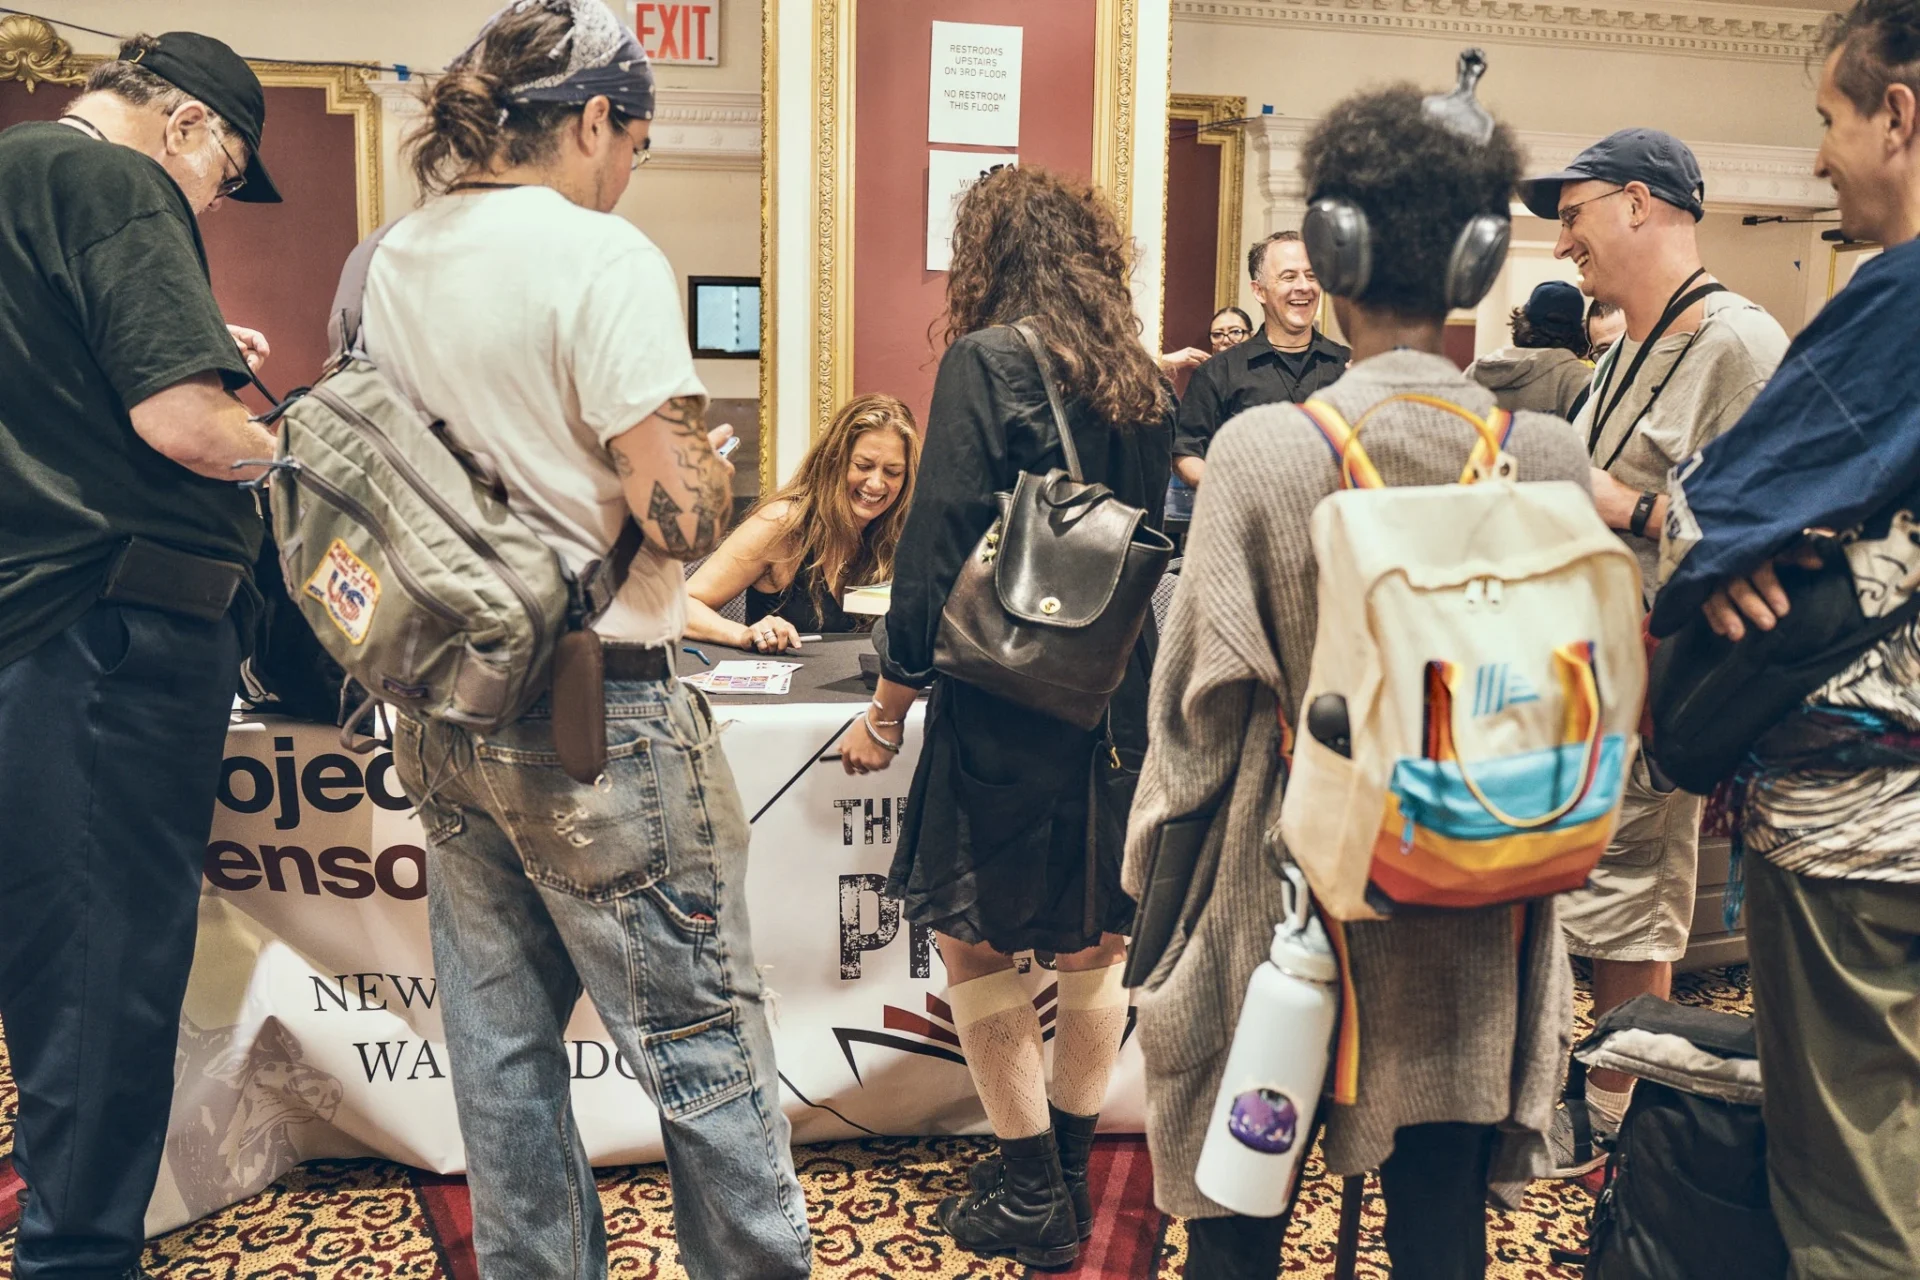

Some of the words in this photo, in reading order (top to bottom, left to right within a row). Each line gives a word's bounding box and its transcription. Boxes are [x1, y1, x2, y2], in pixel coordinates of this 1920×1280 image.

[636, 3, 711, 60] EXIT
[950, 44, 1003, 56] RESTROOMS
[955, 57, 997, 67] UPSTAIRS
[944, 66, 957, 75] ON
[960, 68, 976, 77] 3RD
[979, 69, 1007, 78] FLOOR
[944, 89, 956, 98] NO
[959, 90, 1006, 101] RESTROOM
[949, 101, 969, 111] THIS
[971, 102, 1000, 112] FLOOR
[328, 568, 366, 622] US
[833, 797, 908, 845] TH
